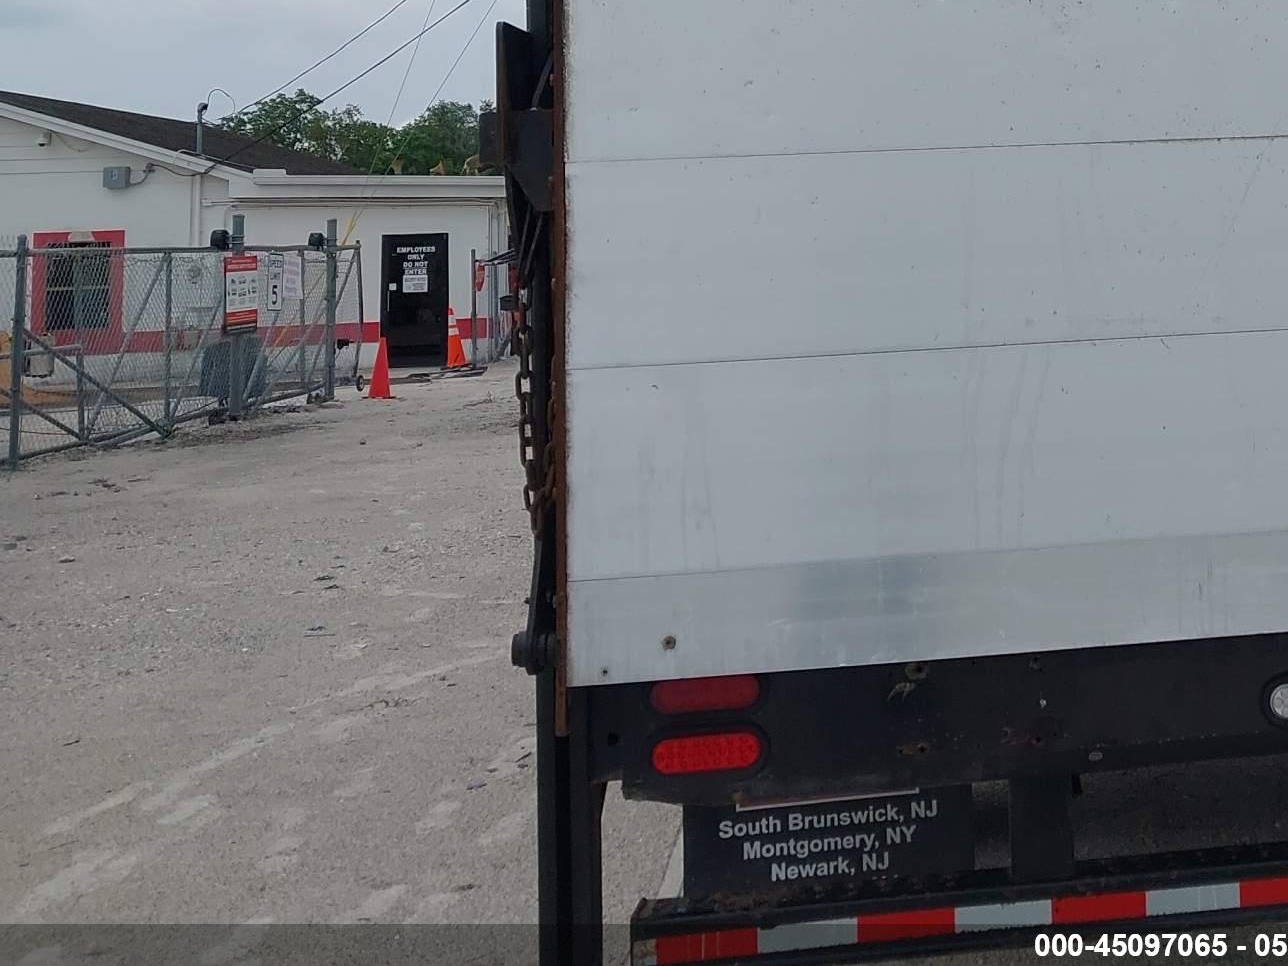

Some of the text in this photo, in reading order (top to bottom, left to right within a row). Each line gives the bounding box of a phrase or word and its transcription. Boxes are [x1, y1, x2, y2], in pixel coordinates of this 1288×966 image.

[396, 246, 436, 254] EMPLOYEES
[272, 284, 278, 305] 5
[718, 799, 938, 839] South Brunswick, NJ
[743, 825, 917, 860] Montgomery, NY
[771, 852, 890, 882] Newark, NJ
